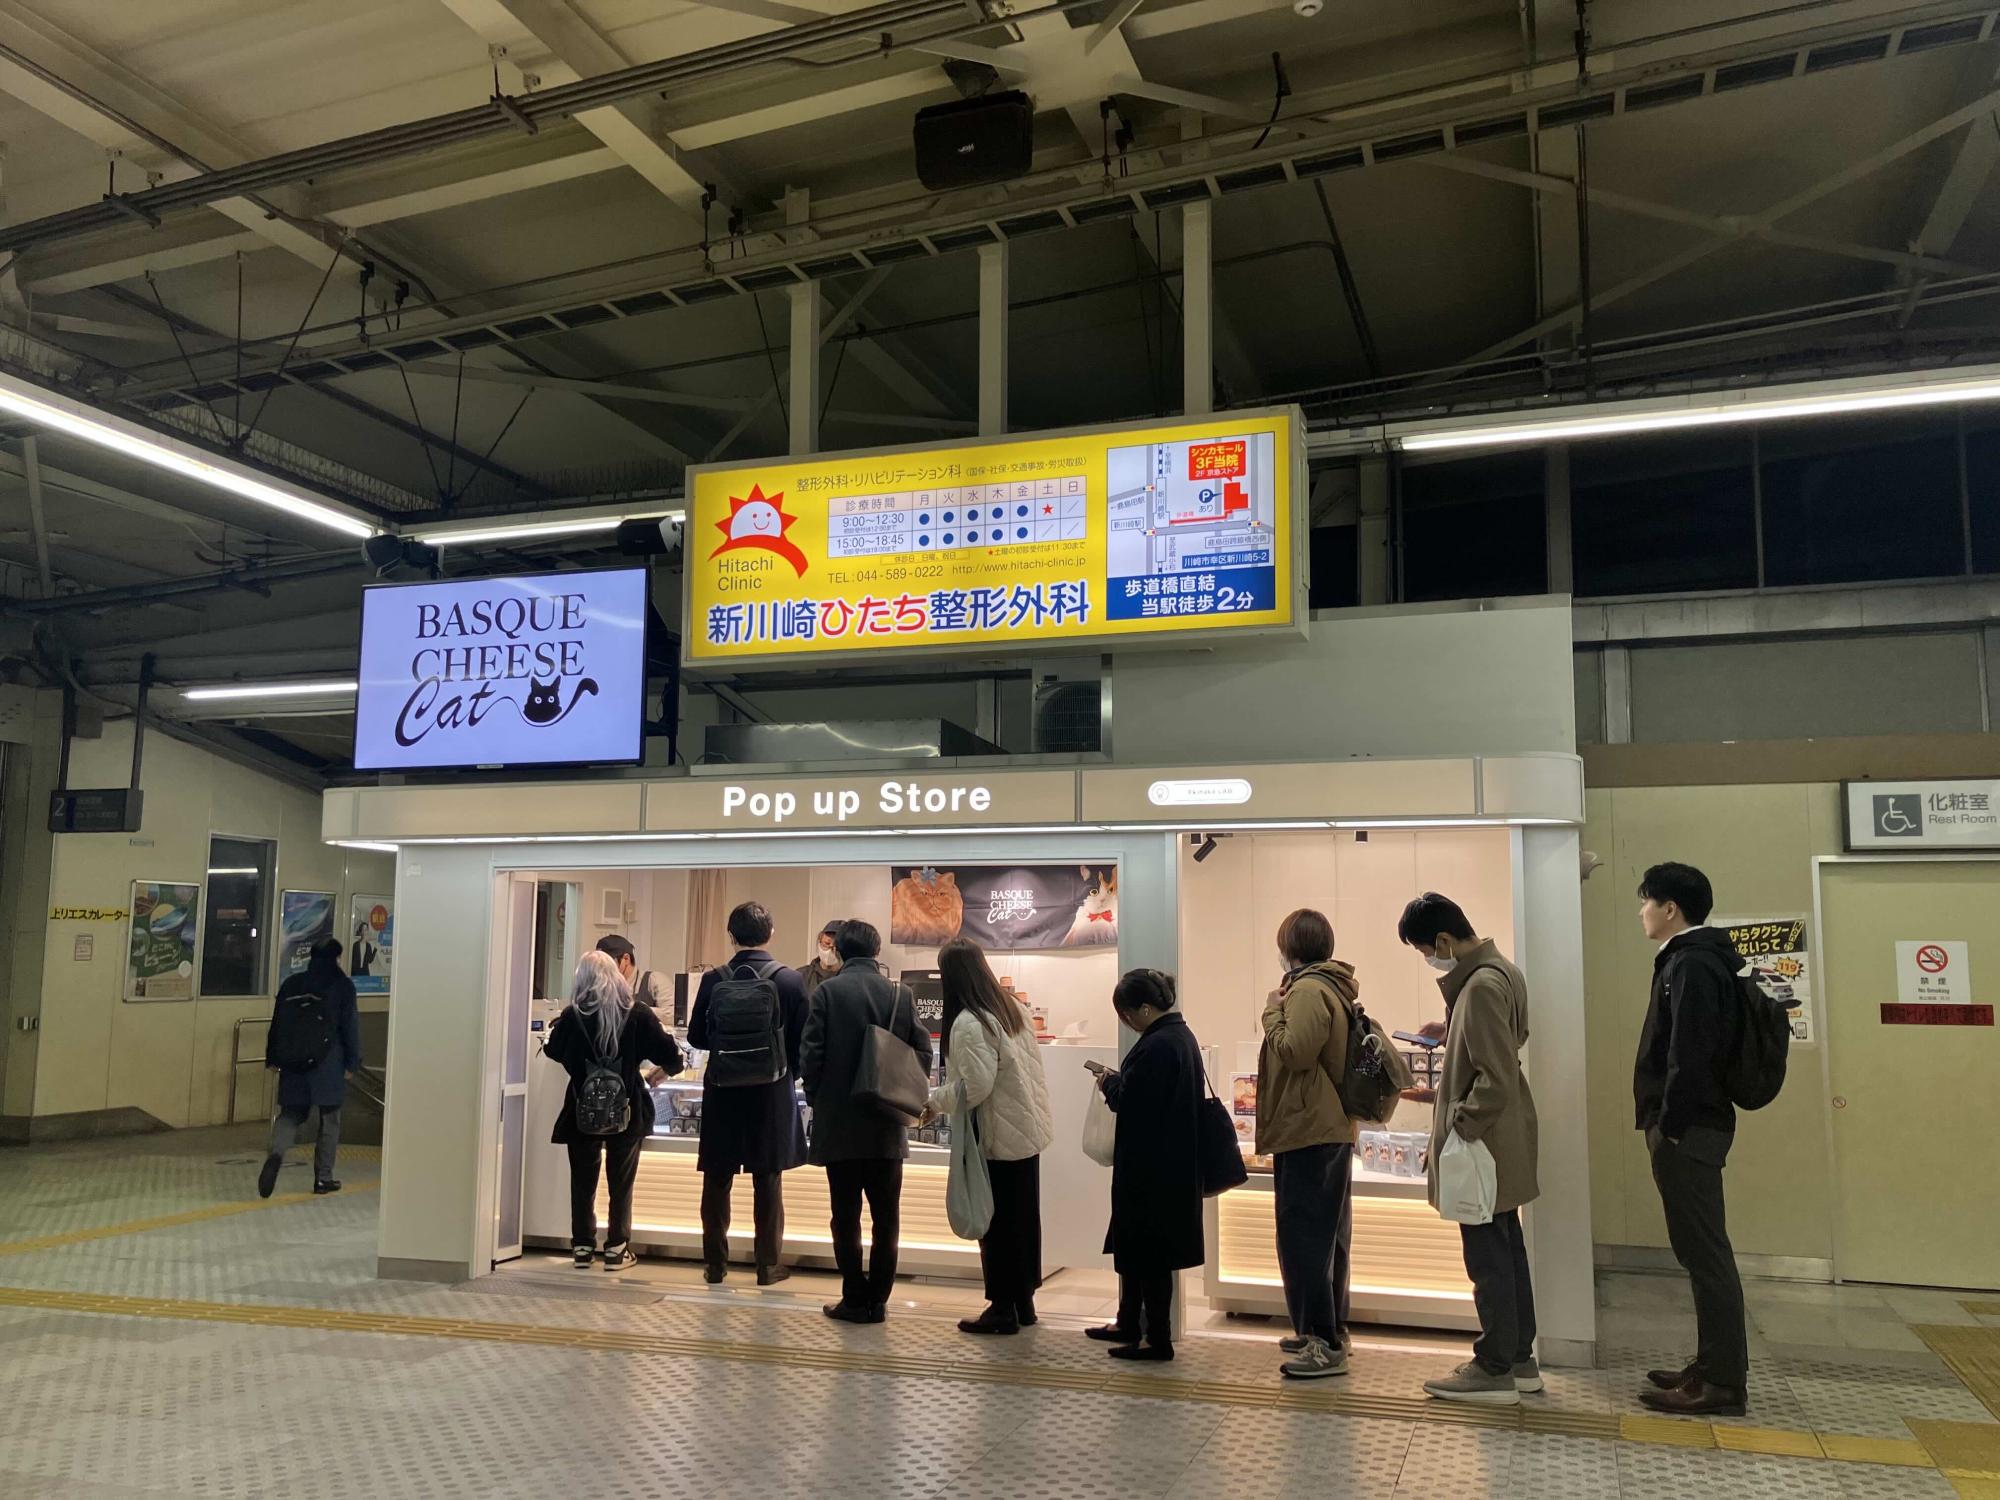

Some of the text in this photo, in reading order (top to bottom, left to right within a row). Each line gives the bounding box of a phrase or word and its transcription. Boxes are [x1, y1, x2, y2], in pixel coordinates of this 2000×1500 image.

[1191, 444, 1243, 456] シンカモール
[1196, 455, 1239, 469] 3F当院
[845, 481, 1079, 511] 診療時間 月 火 水 木 金 土 日
[718, 556, 773, 573] Hitachi
[952, 557, 1086, 575] http://www.hitachi-clinic.jp
[718, 577, 762, 591] Clinic
[1125, 574, 1216, 597] 歩道橋直結
[1141, 586, 1254, 616] 当駅徒歩2分
[416, 593, 587, 639] BASQUE
[708, 580, 1089, 643] 新川崎ひたち整形外科
[412, 640, 585, 683] CHEESE
[395, 676, 496, 747] Cat
[54, 797, 65, 817] 2
[723, 781, 991, 822] Pop up Store
[1928, 793, 1989, 811] 化粧室
[1929, 814, 1997, 824] Rest Room
[991, 890, 1034, 900] BASQUE
[990, 900, 1034, 909] CHEESE
[987, 908, 1012, 924] Cat
[1780, 962, 1797, 972] 119
